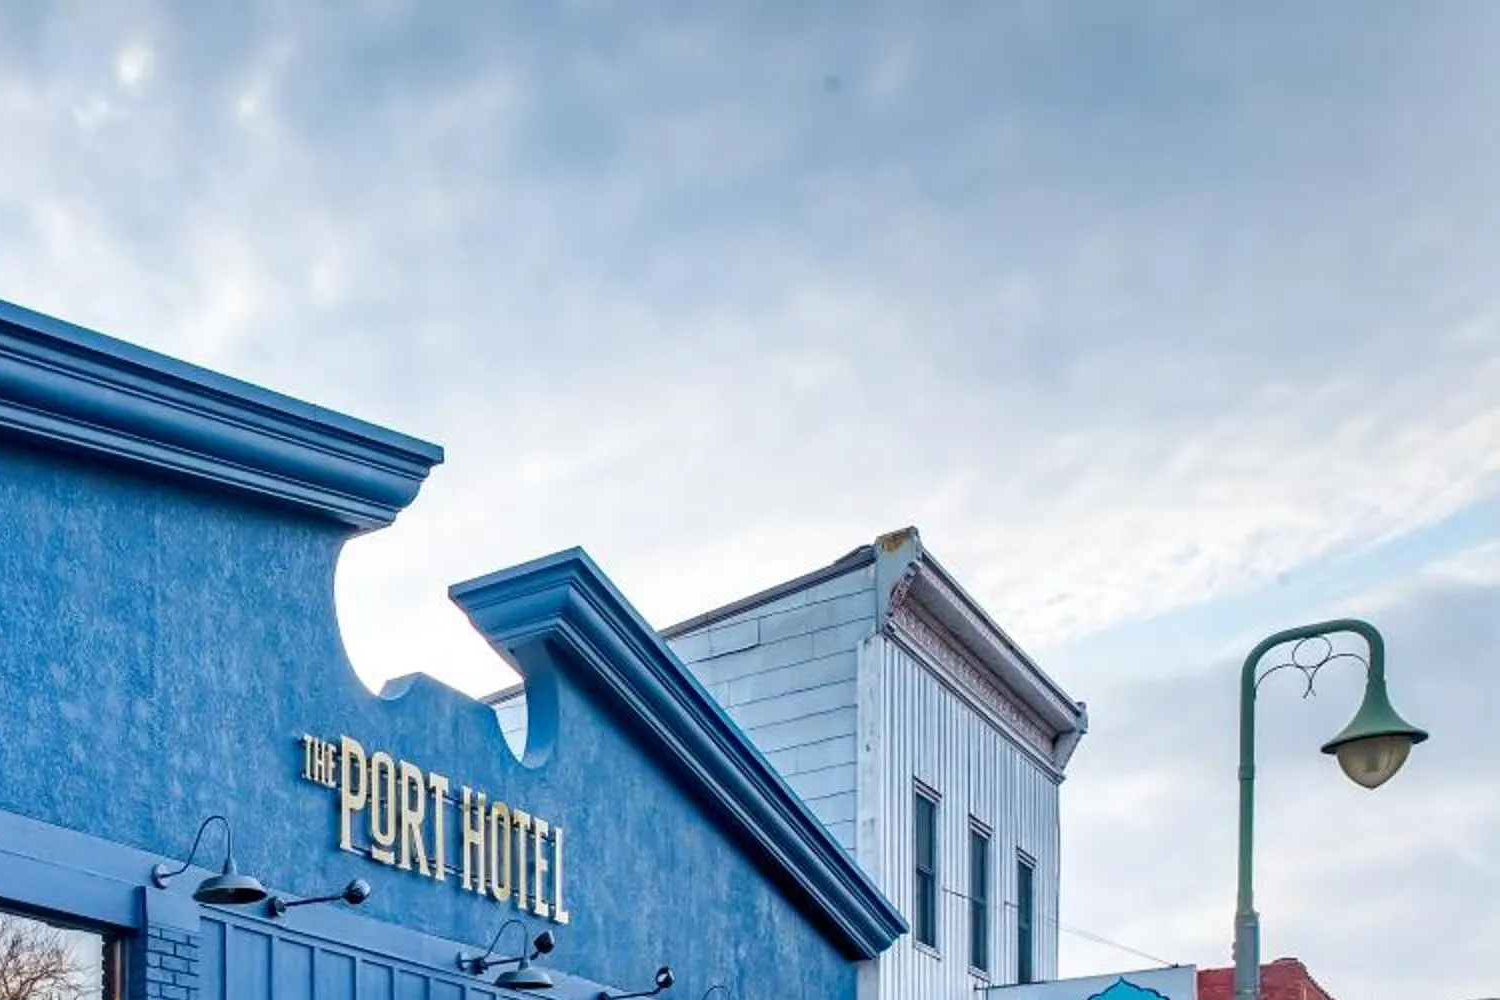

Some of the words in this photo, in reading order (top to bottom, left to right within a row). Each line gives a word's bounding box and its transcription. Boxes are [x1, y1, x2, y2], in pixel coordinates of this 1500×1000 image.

[303, 733, 337, 788] THE
[339, 733, 449, 881] PORT
[461, 785, 570, 925] HOTEL
